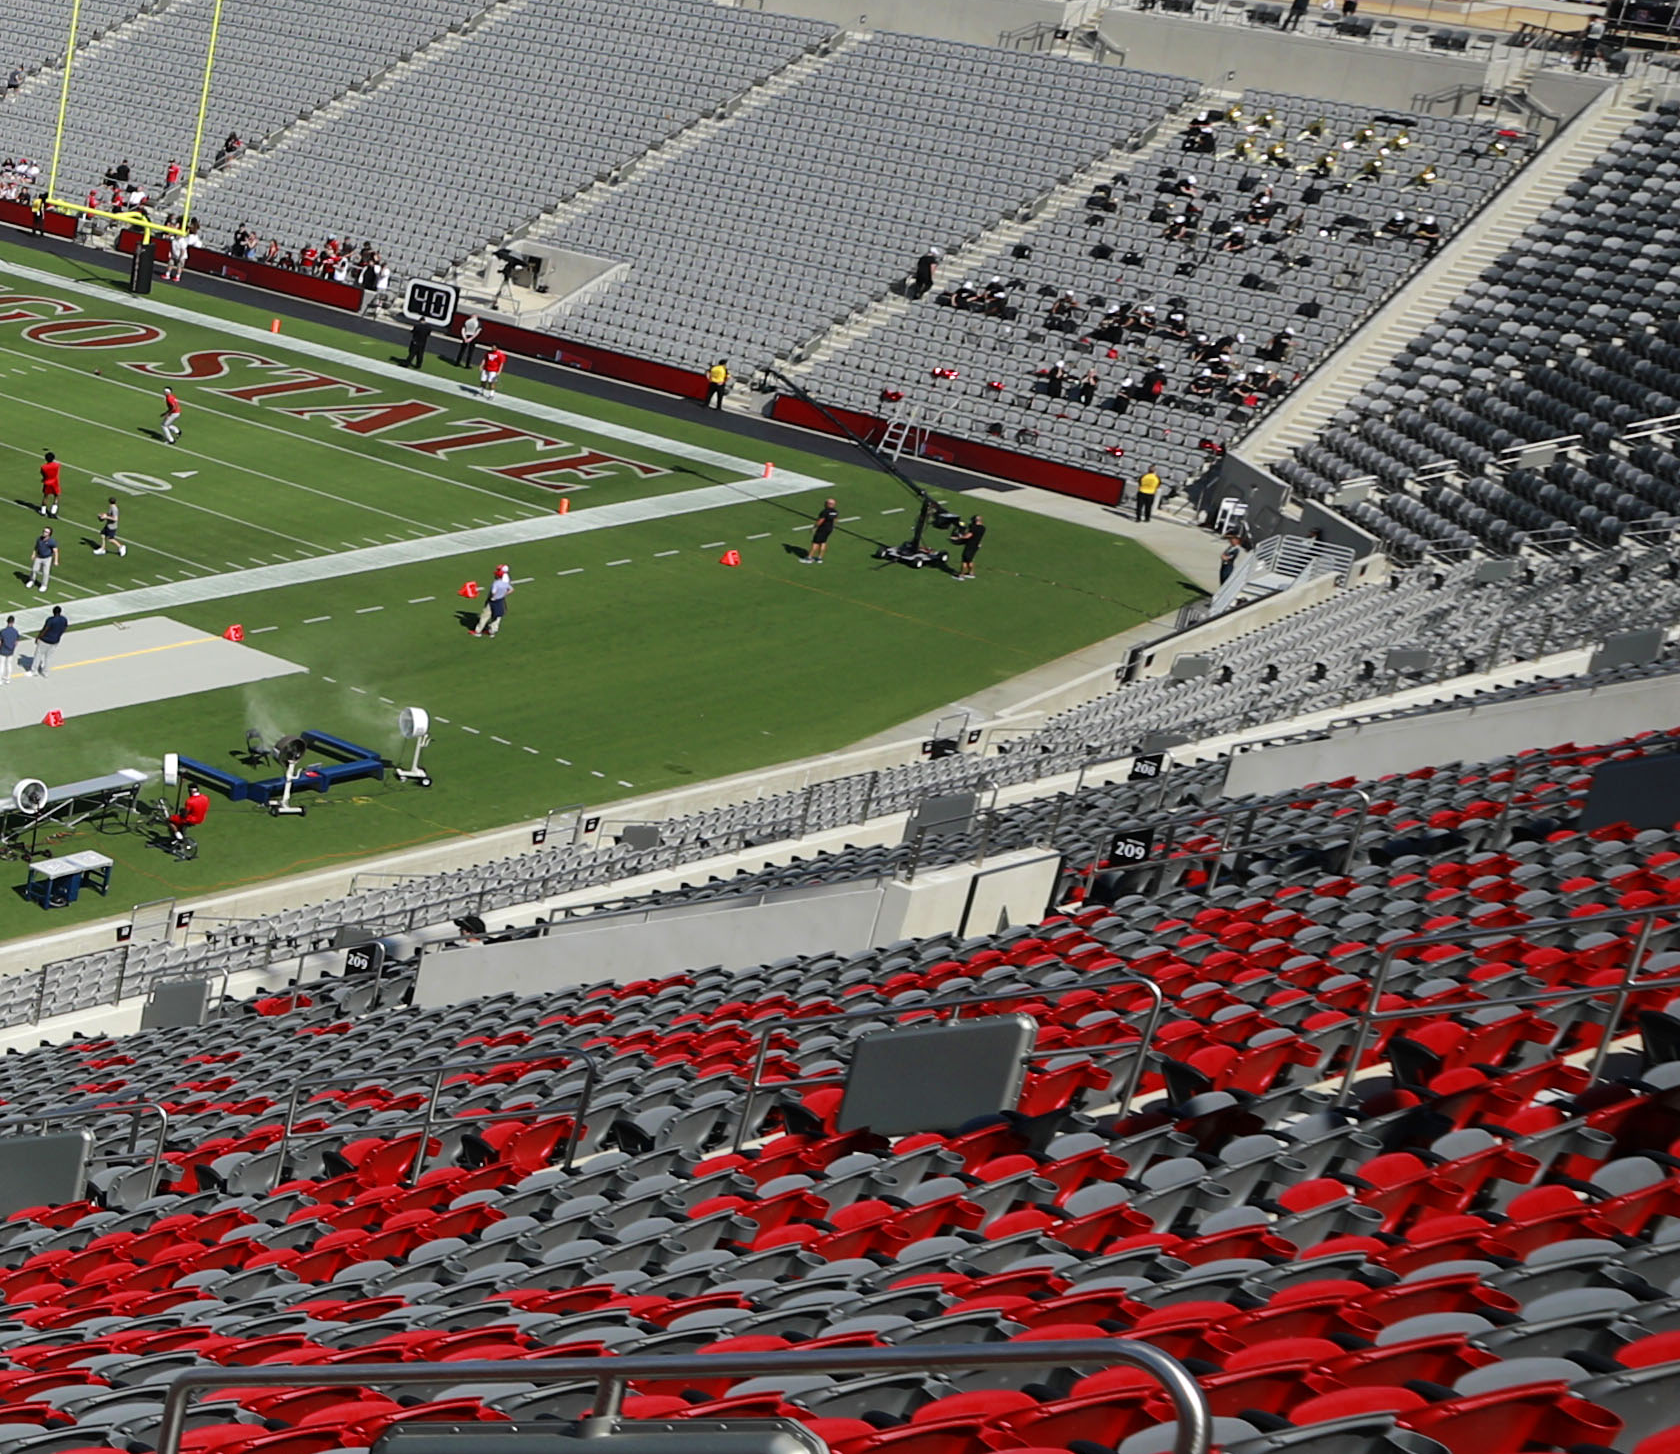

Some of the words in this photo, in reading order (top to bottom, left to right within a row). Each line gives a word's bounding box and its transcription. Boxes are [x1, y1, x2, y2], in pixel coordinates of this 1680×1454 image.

[414, 288, 446, 318] 40
[119, 347, 674, 495] STATE
[91, 469, 174, 497] 10
[1134, 761, 1156, 776] 208
[1114, 841, 1145, 859] 209
[347, 953, 368, 970] 209
